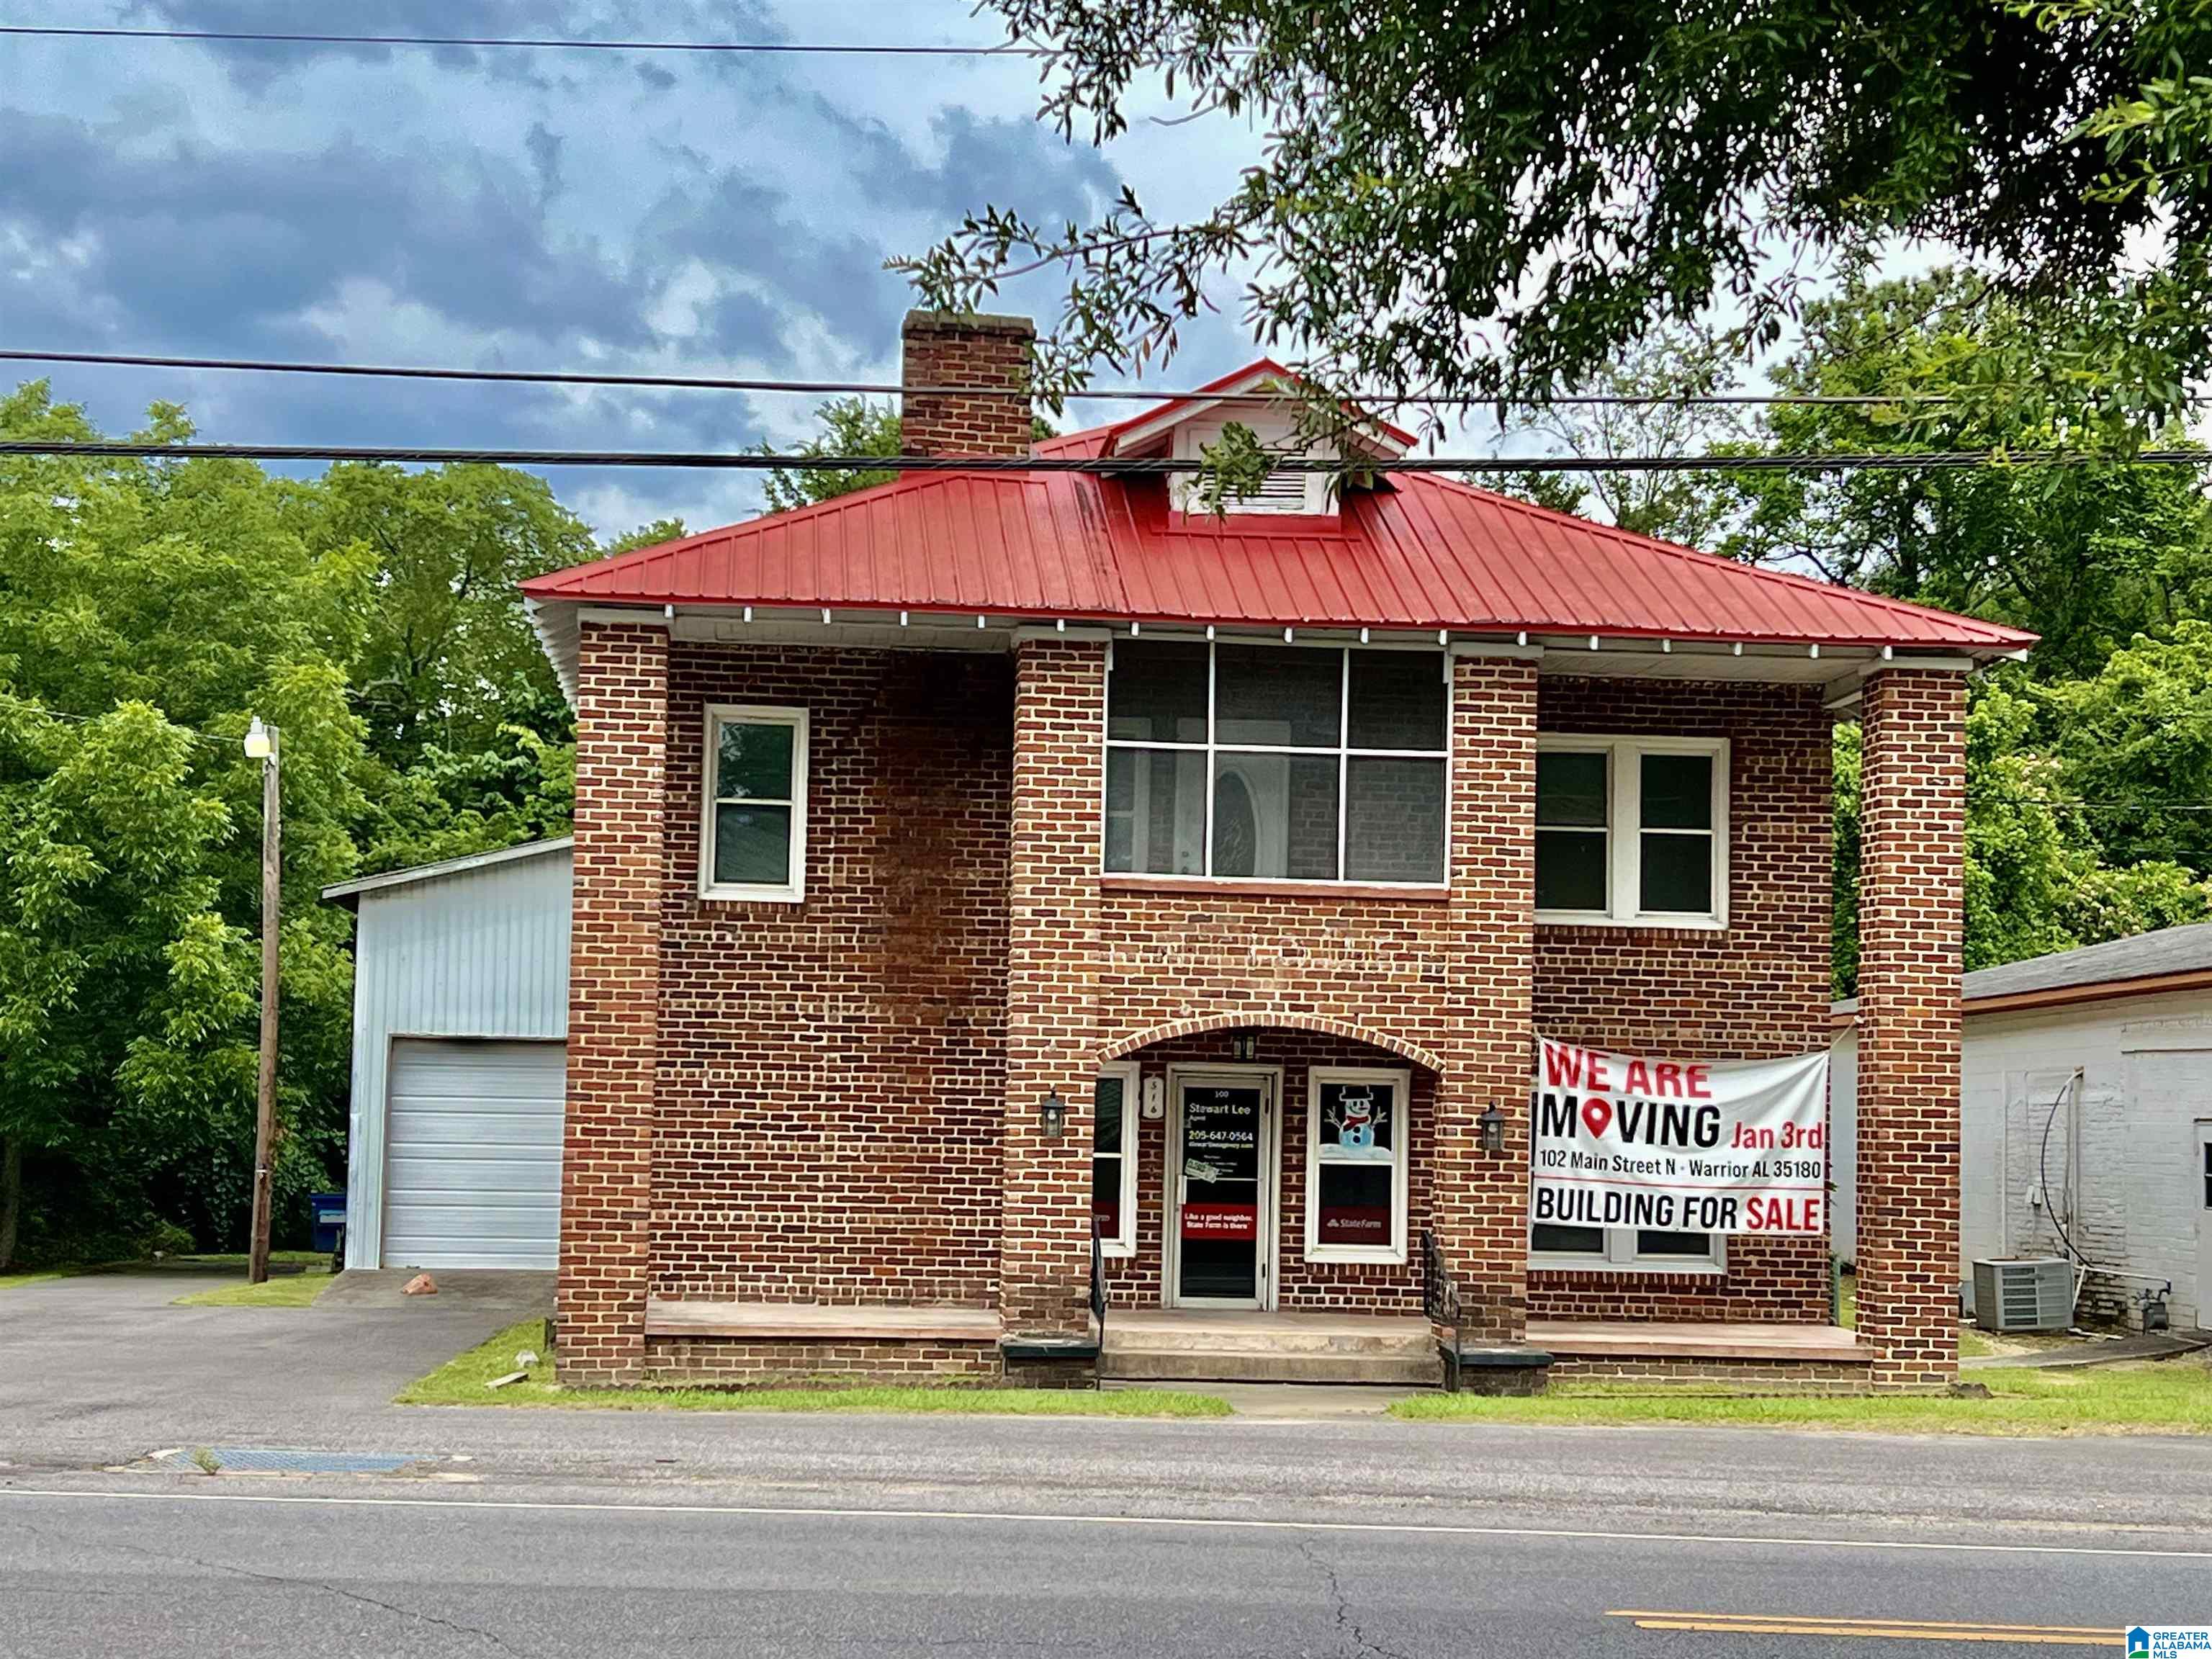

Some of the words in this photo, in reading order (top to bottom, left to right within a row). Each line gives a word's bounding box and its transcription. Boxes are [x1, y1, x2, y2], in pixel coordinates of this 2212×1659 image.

[1544, 1043, 1611, 1092] WE
[1624, 1060, 1713, 1099] ARE
[1189, 1102, 1228, 1114] Stewart
[1231, 1105, 1251, 1115] Lee
[1541, 1094, 1721, 1148] MOVING
[1730, 1122, 1774, 1149] Jan
[1780, 1121, 1823, 1149] 3rd
[1540, 1151, 1566, 1168] 102
[1571, 1154, 1607, 1172] Main
[1612, 1156, 1661, 1175] Street
[1665, 1159, 1676, 1175] N
[1689, 1159, 1748, 1178] Warrior
[1752, 1161, 1769, 1178] AL
[1773, 1161, 1821, 1179] 35180
[1536, 1187, 1674, 1226] BUILDING
[1683, 1197, 1737, 1229] FOR
[1746, 1197, 1820, 1231] SALE
